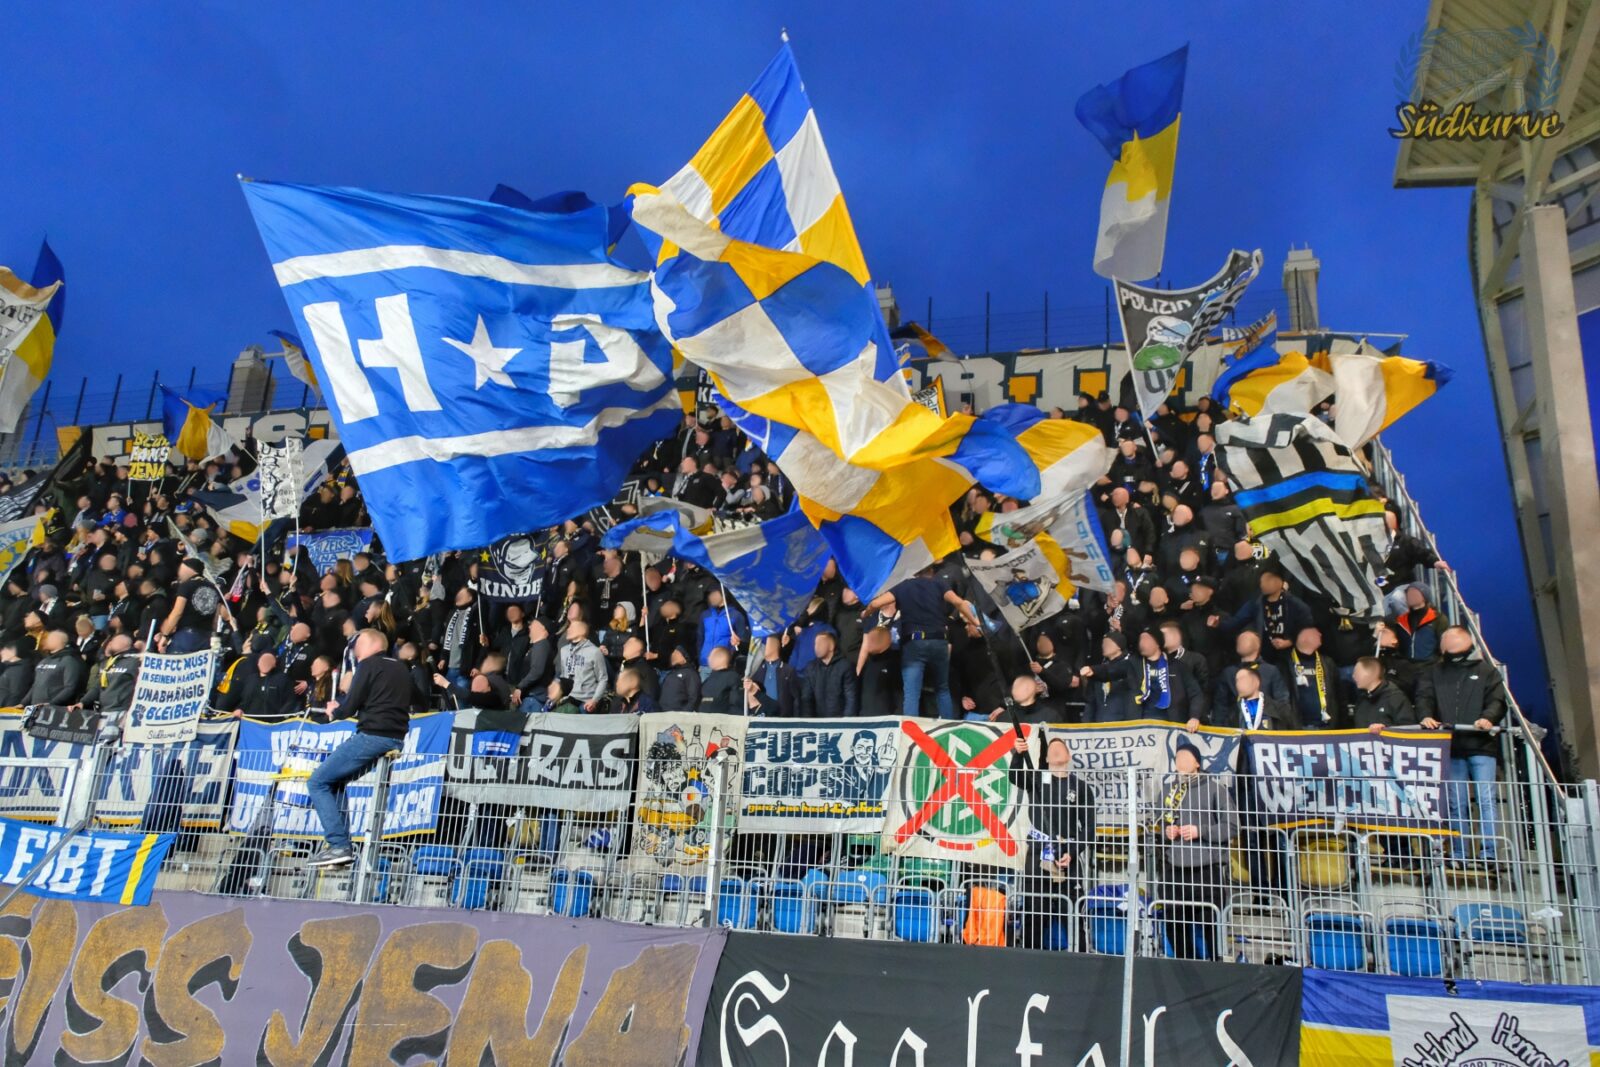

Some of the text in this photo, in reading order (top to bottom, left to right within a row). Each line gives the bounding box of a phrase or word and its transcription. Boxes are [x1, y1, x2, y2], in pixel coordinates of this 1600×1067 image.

[479, 577, 543, 598] KINDE
[144, 653, 209, 671] DER FCC MUSS
[137, 683, 205, 703] UNABHÄNGIG
[35, 704, 95, 730] DIY
[145, 701, 201, 721] BLEIBEN
[744, 731, 844, 763] FUCK
[1064, 734, 1157, 751] UTZE DAS
[447, 731, 630, 787] ULTRAS
[1071, 750, 1141, 770] SPIEL
[1253, 740, 1442, 782] REFUGEES
[742, 766, 845, 800] COPS
[1257, 776, 1443, 820] WELCOME
[265, 913, 702, 1067] JENA
